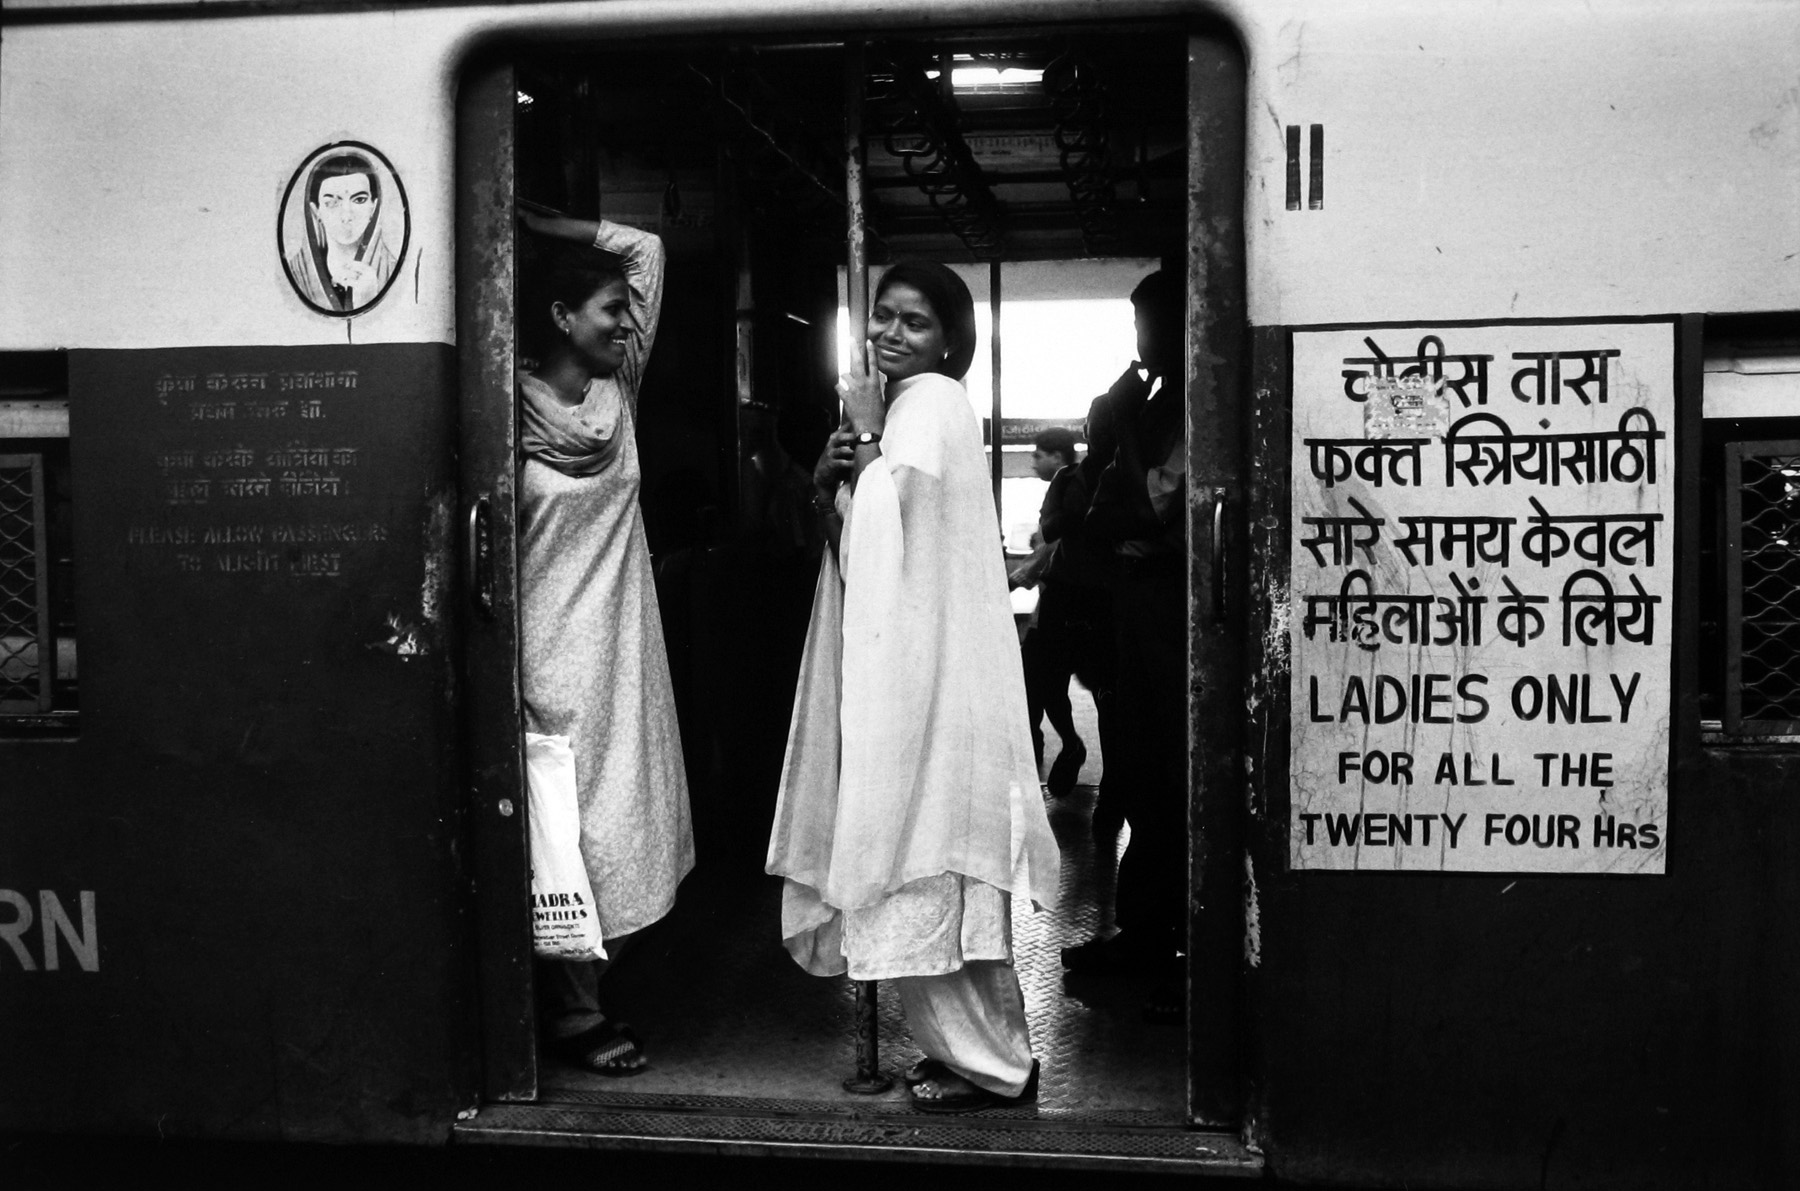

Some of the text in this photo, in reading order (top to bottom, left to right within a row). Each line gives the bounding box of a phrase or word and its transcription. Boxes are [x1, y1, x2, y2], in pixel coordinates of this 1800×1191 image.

[1511, 349, 1620, 405] तास
[1304, 407, 1666, 488] फक्त स्त्रियांसाठी
[128, 526, 196, 544] PLEASE
[203, 525, 264, 544] ALLOW
[1300, 496, 1663, 568] सारे समय केवल
[177, 554, 202, 572] TO
[1302, 569, 1661, 651] महिलाओं के लिये
[1310, 672, 1641, 724] LADIES ONLY
[1338, 750, 1614, 787] FOR ALL THE
[1299, 812, 1467, 848] TWENTY
[1485, 813, 1581, 848] FOUR
